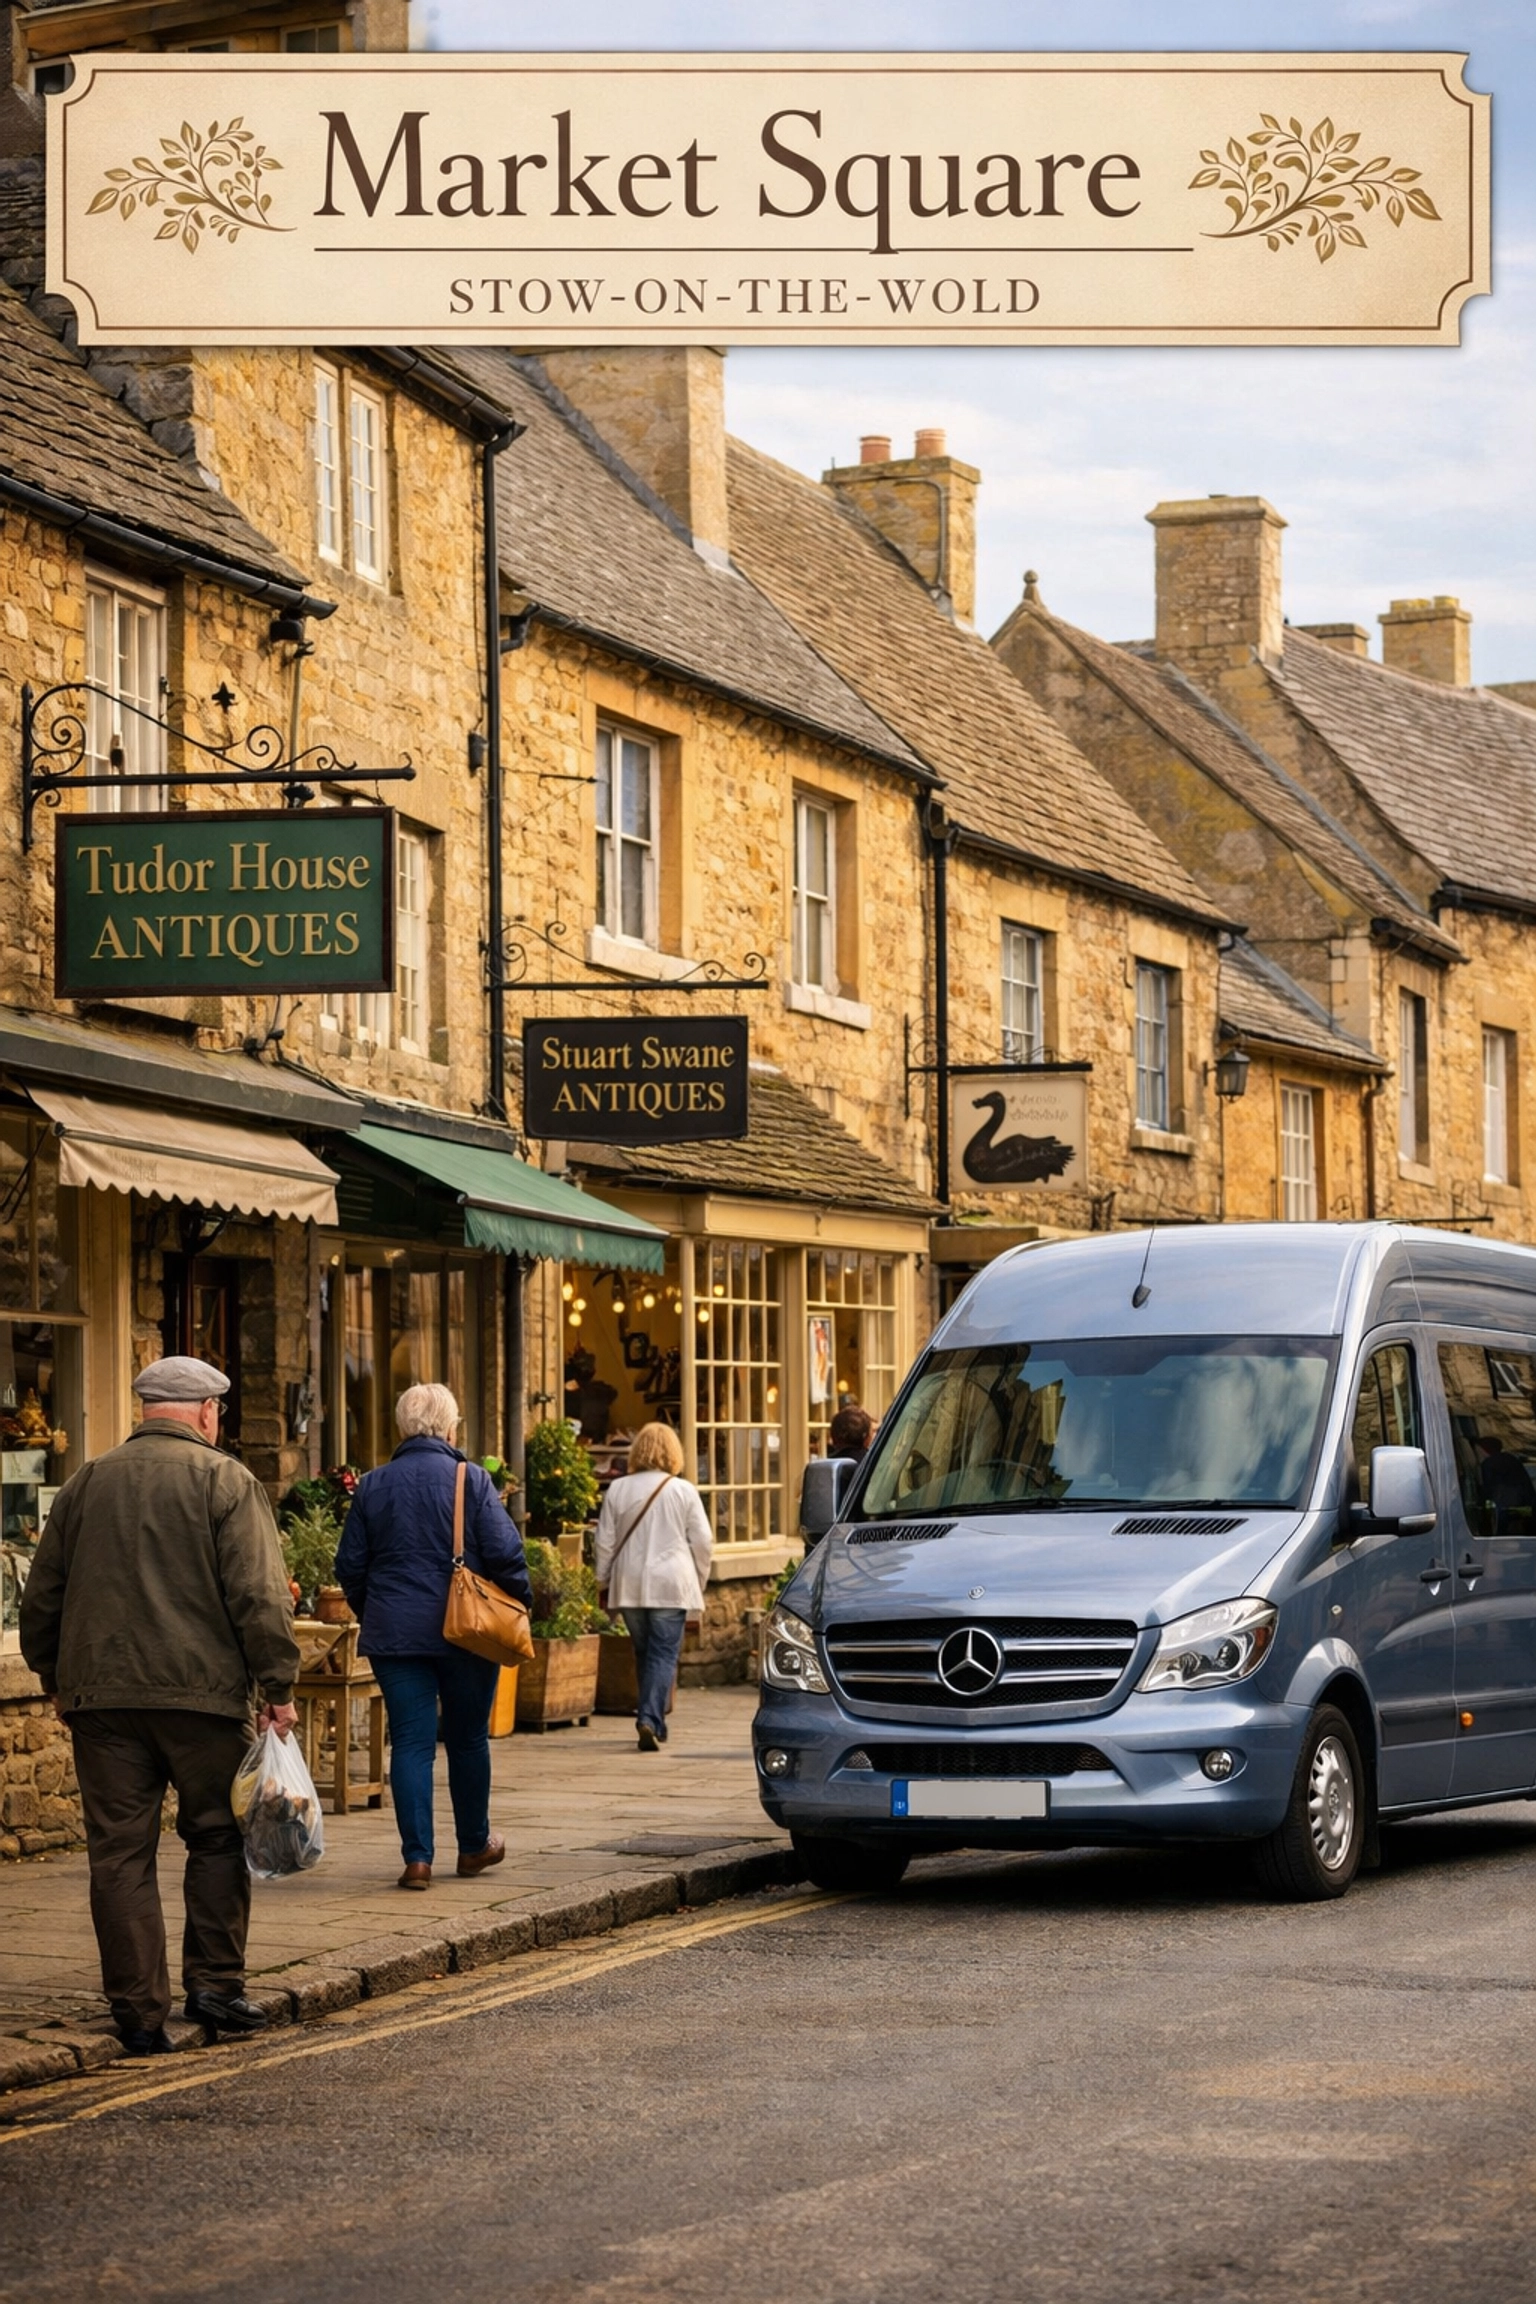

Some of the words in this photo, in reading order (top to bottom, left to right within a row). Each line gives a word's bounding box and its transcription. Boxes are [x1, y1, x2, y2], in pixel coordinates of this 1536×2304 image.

[76, 843, 214, 895] Tudor
[229, 842, 371, 890] House
[90, 911, 361, 967] ANTIQUES
[542, 1036, 633, 1070] Stuart
[641, 1036, 734, 1069] Swane
[552, 1081, 726, 1119] ANTIQUES
